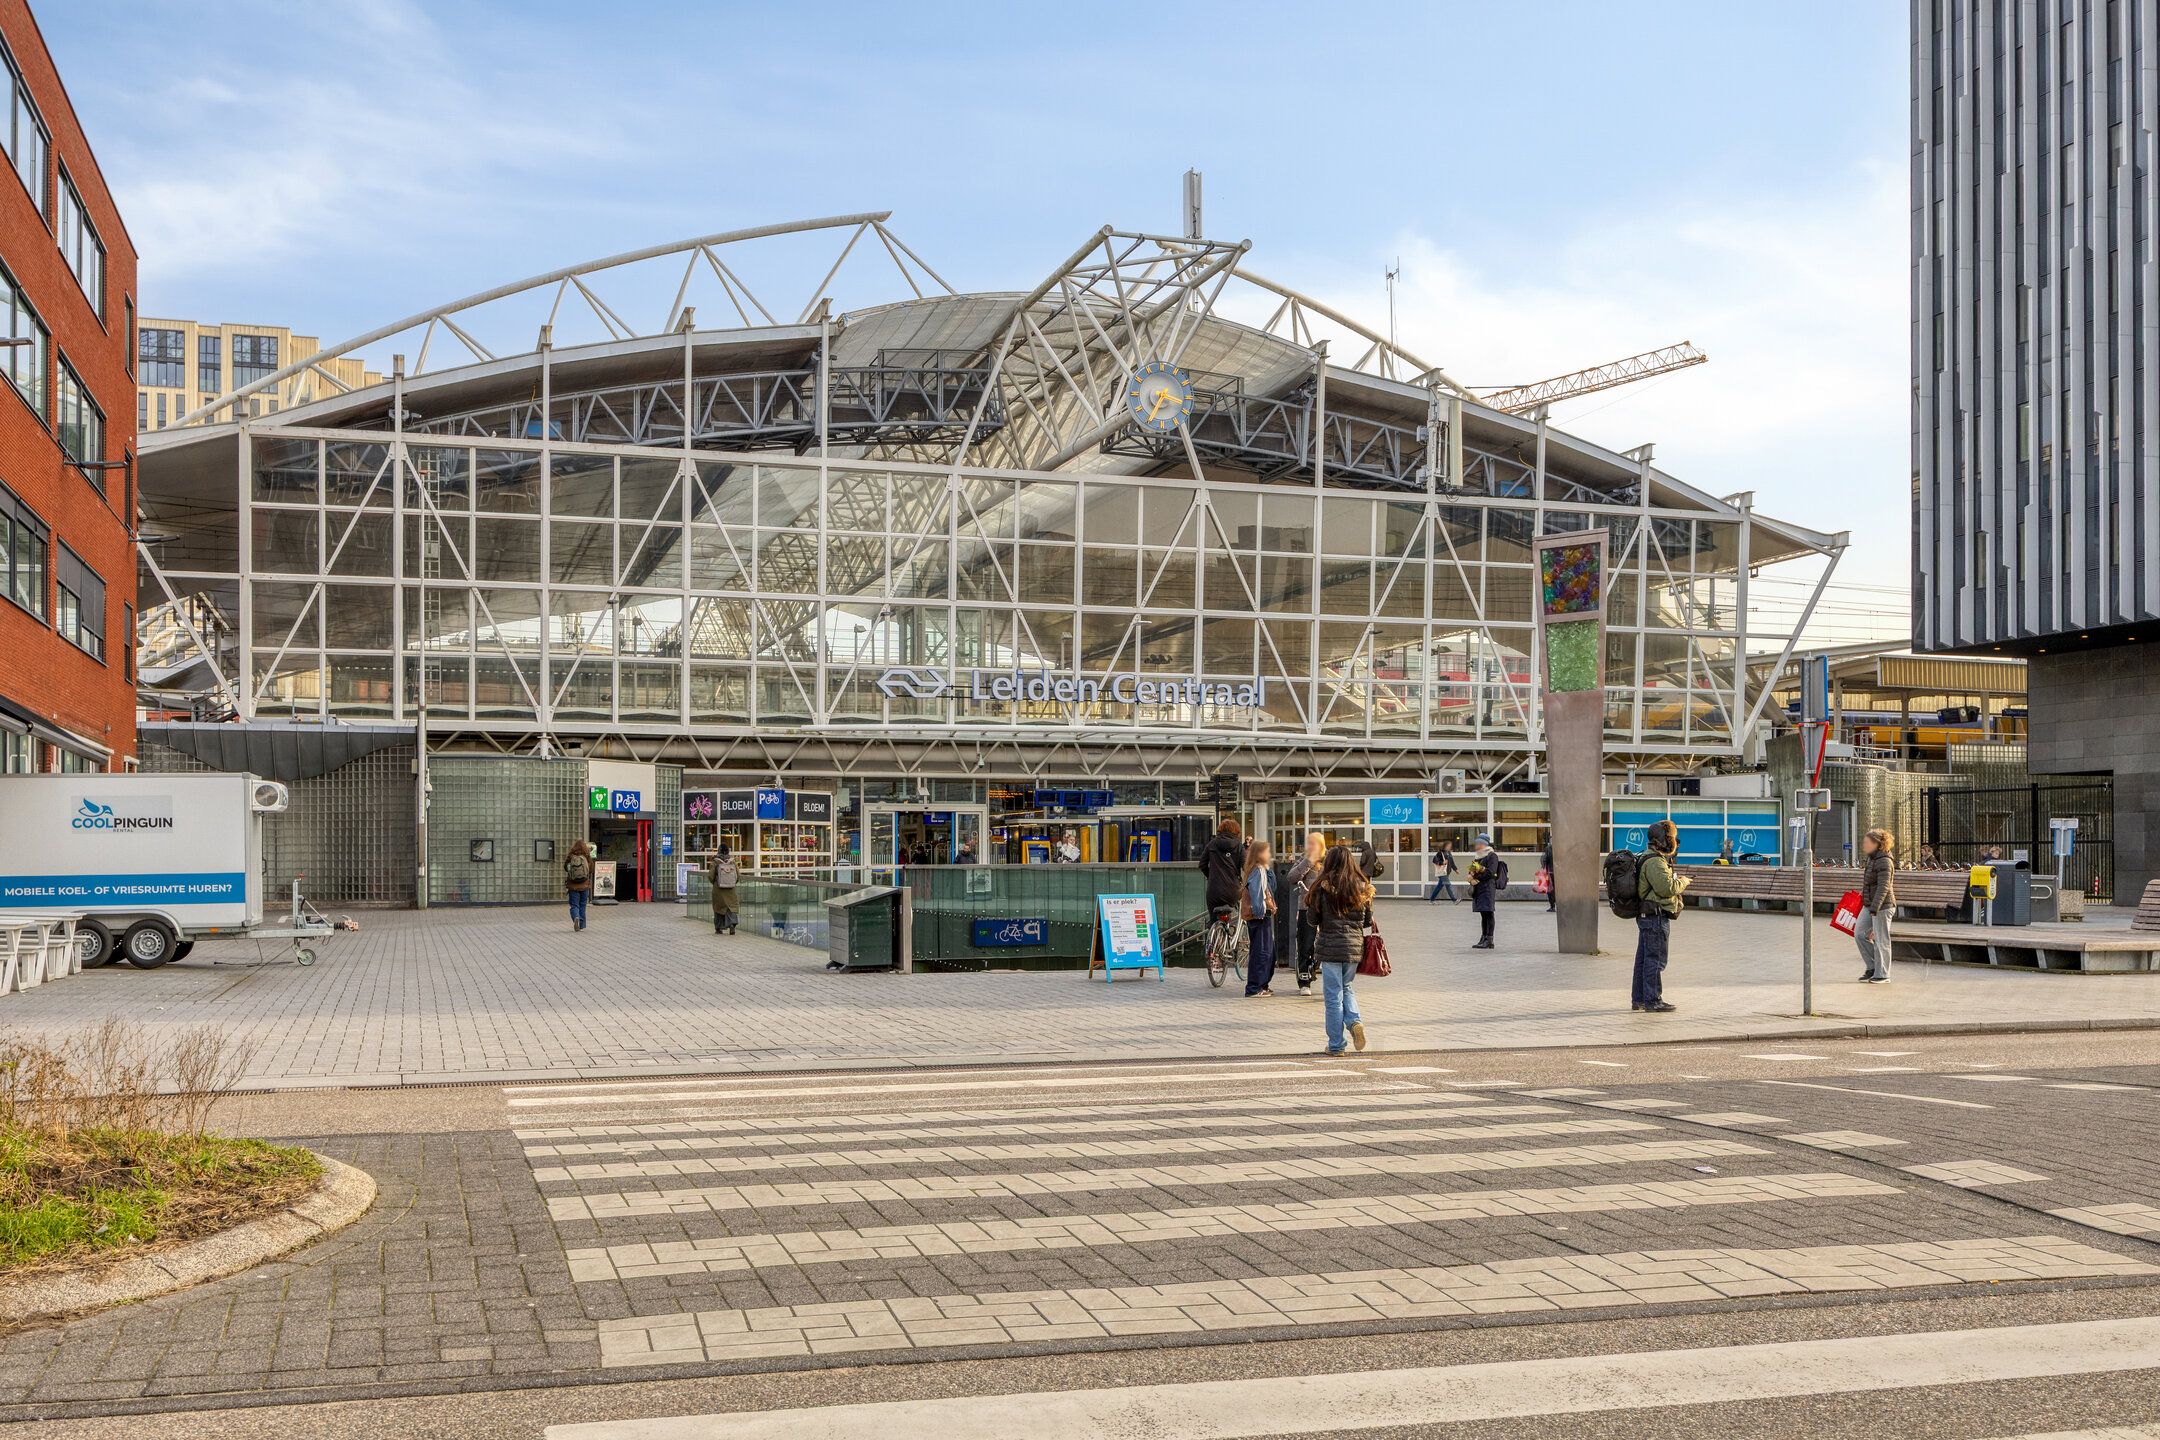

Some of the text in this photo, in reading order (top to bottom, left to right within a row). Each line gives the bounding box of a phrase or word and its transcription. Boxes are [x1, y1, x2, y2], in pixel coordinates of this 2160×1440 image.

[971, 669, 1266, 708] Leiden Centraal
[615, 793, 624, 809] P
[759, 793, 766, 805] P
[722, 800, 753, 811] BLOEM!
[803, 802, 825, 813] BLOEM!
[72, 817, 173, 829] COOLPINGUIN
[5, 883, 232, 896] MOBIELE KOEL- OF VRIESRUIMTE HUREN?
[1121, 898, 1137, 906] plek?
[1835, 908, 1857, 931] Dir
